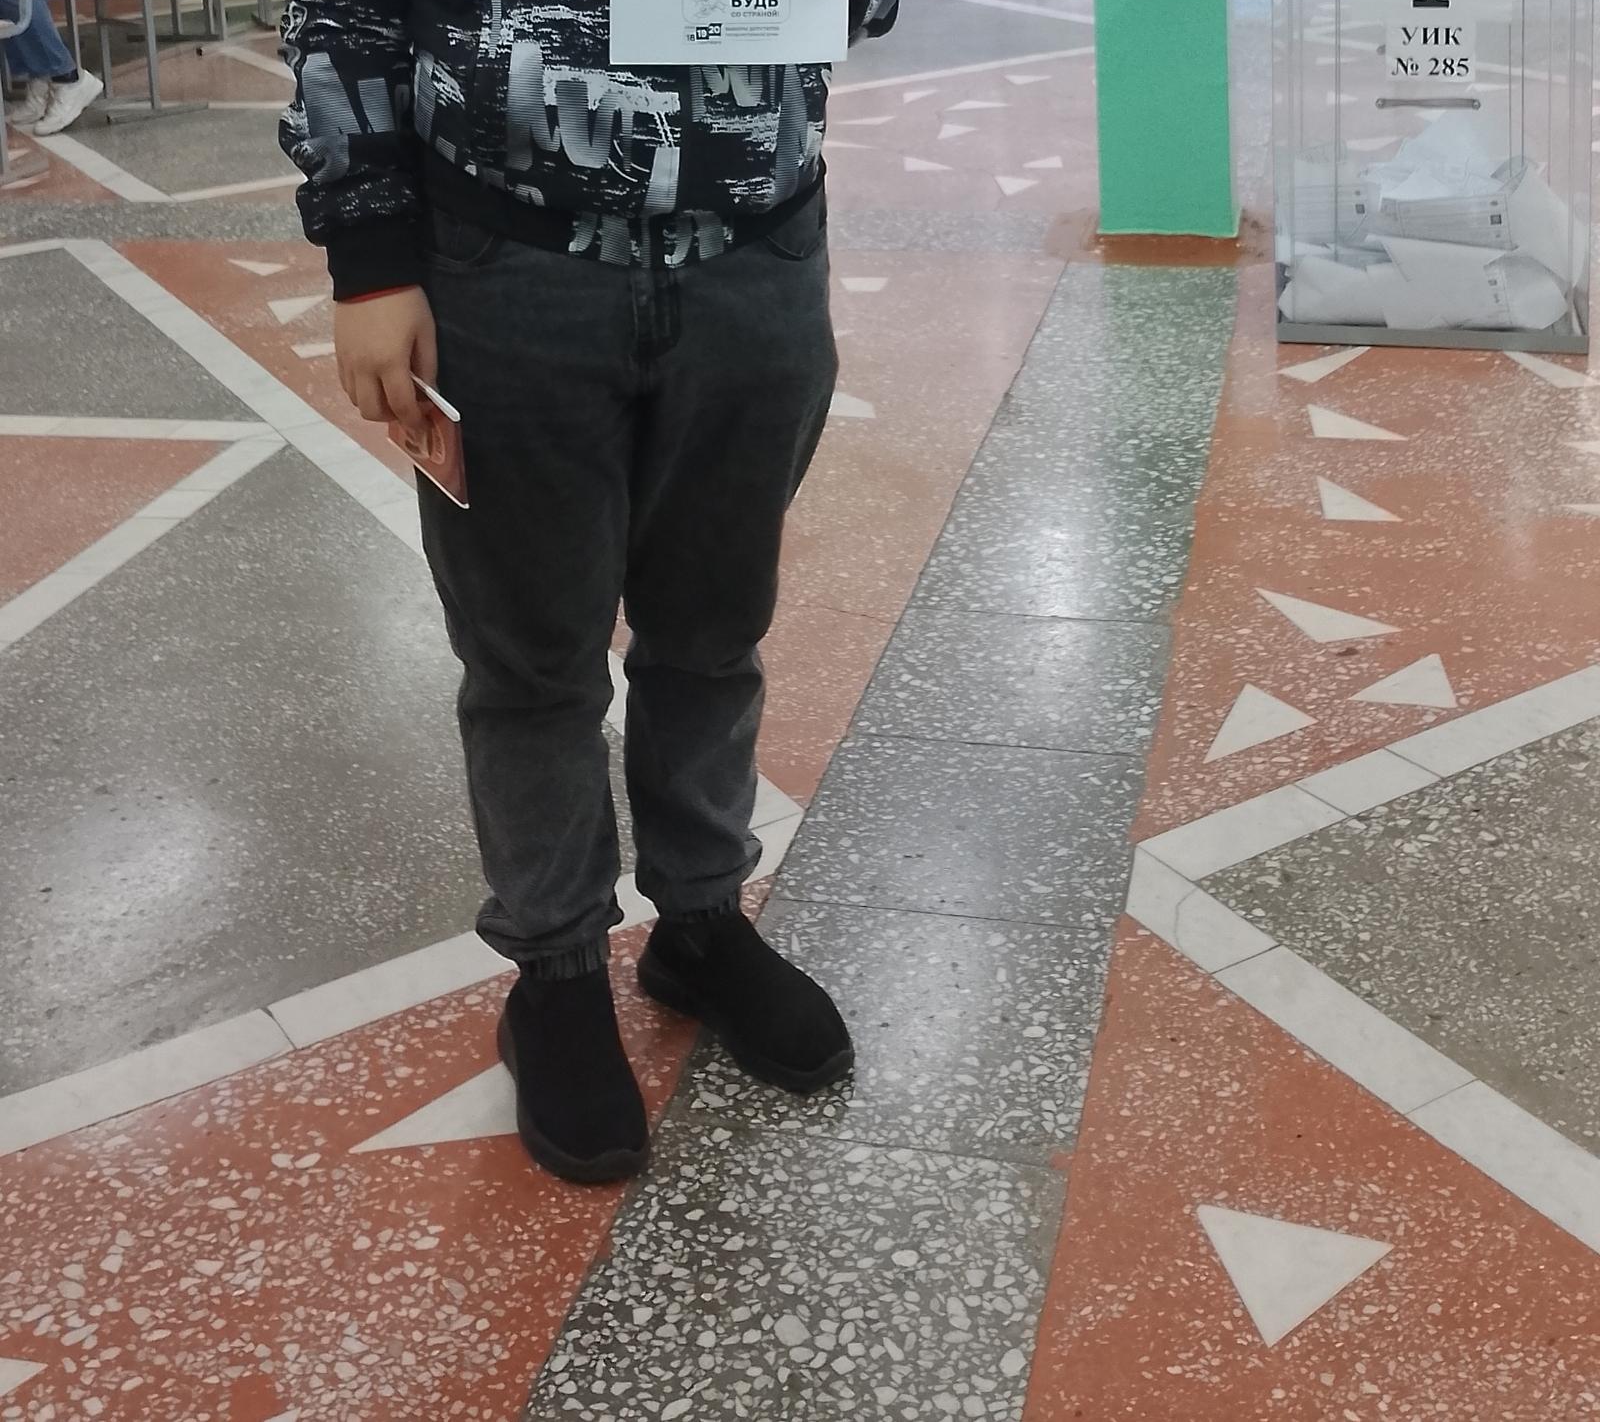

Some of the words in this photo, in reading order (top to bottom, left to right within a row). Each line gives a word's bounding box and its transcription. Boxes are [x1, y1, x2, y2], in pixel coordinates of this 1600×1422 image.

[687, 34, 696, 42] 18
[708, 25, 721, 35] 20
[1401, 27, 1463, 46] УИК
[1392, 57, 1420, 77] №
[1428, 57, 1470, 77] 285
